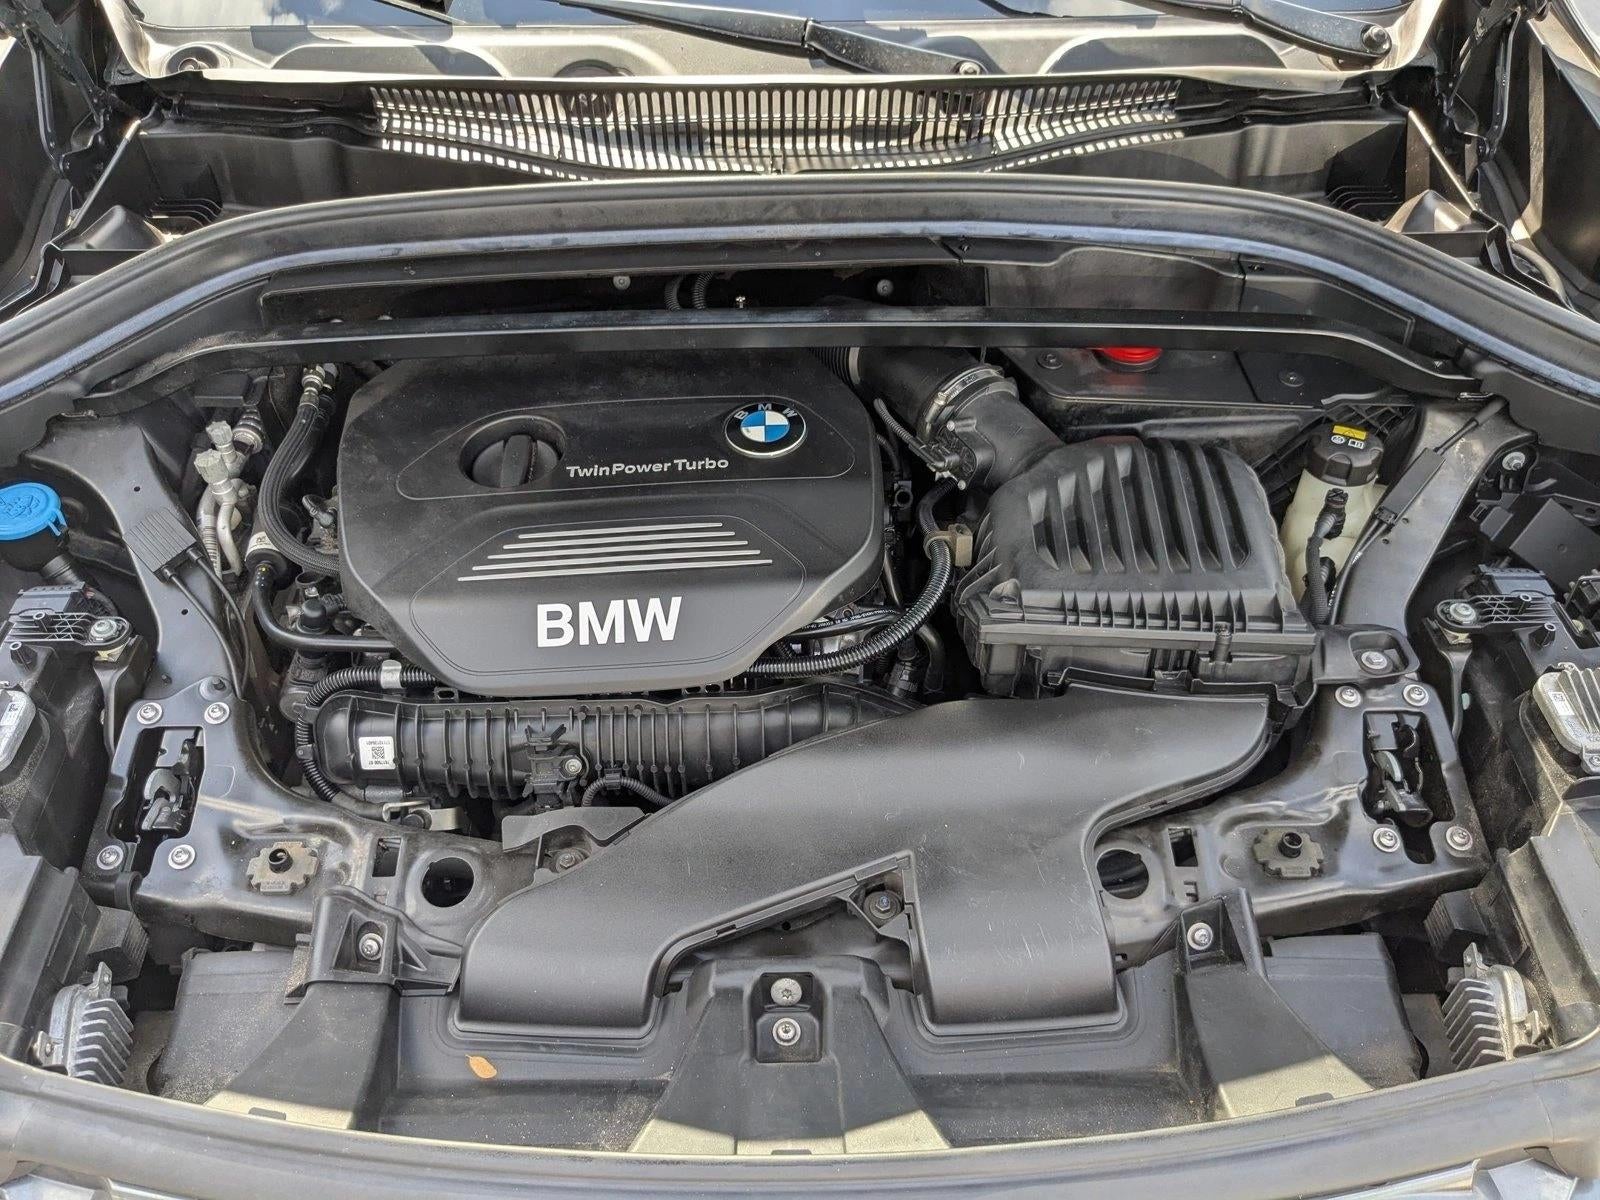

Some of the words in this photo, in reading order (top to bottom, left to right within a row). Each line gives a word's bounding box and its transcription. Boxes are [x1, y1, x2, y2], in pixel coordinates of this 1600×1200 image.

[734, 403, 798, 420] BMW
[674, 457, 729, 471] Turbo
[537, 596, 682, 647] BMW
